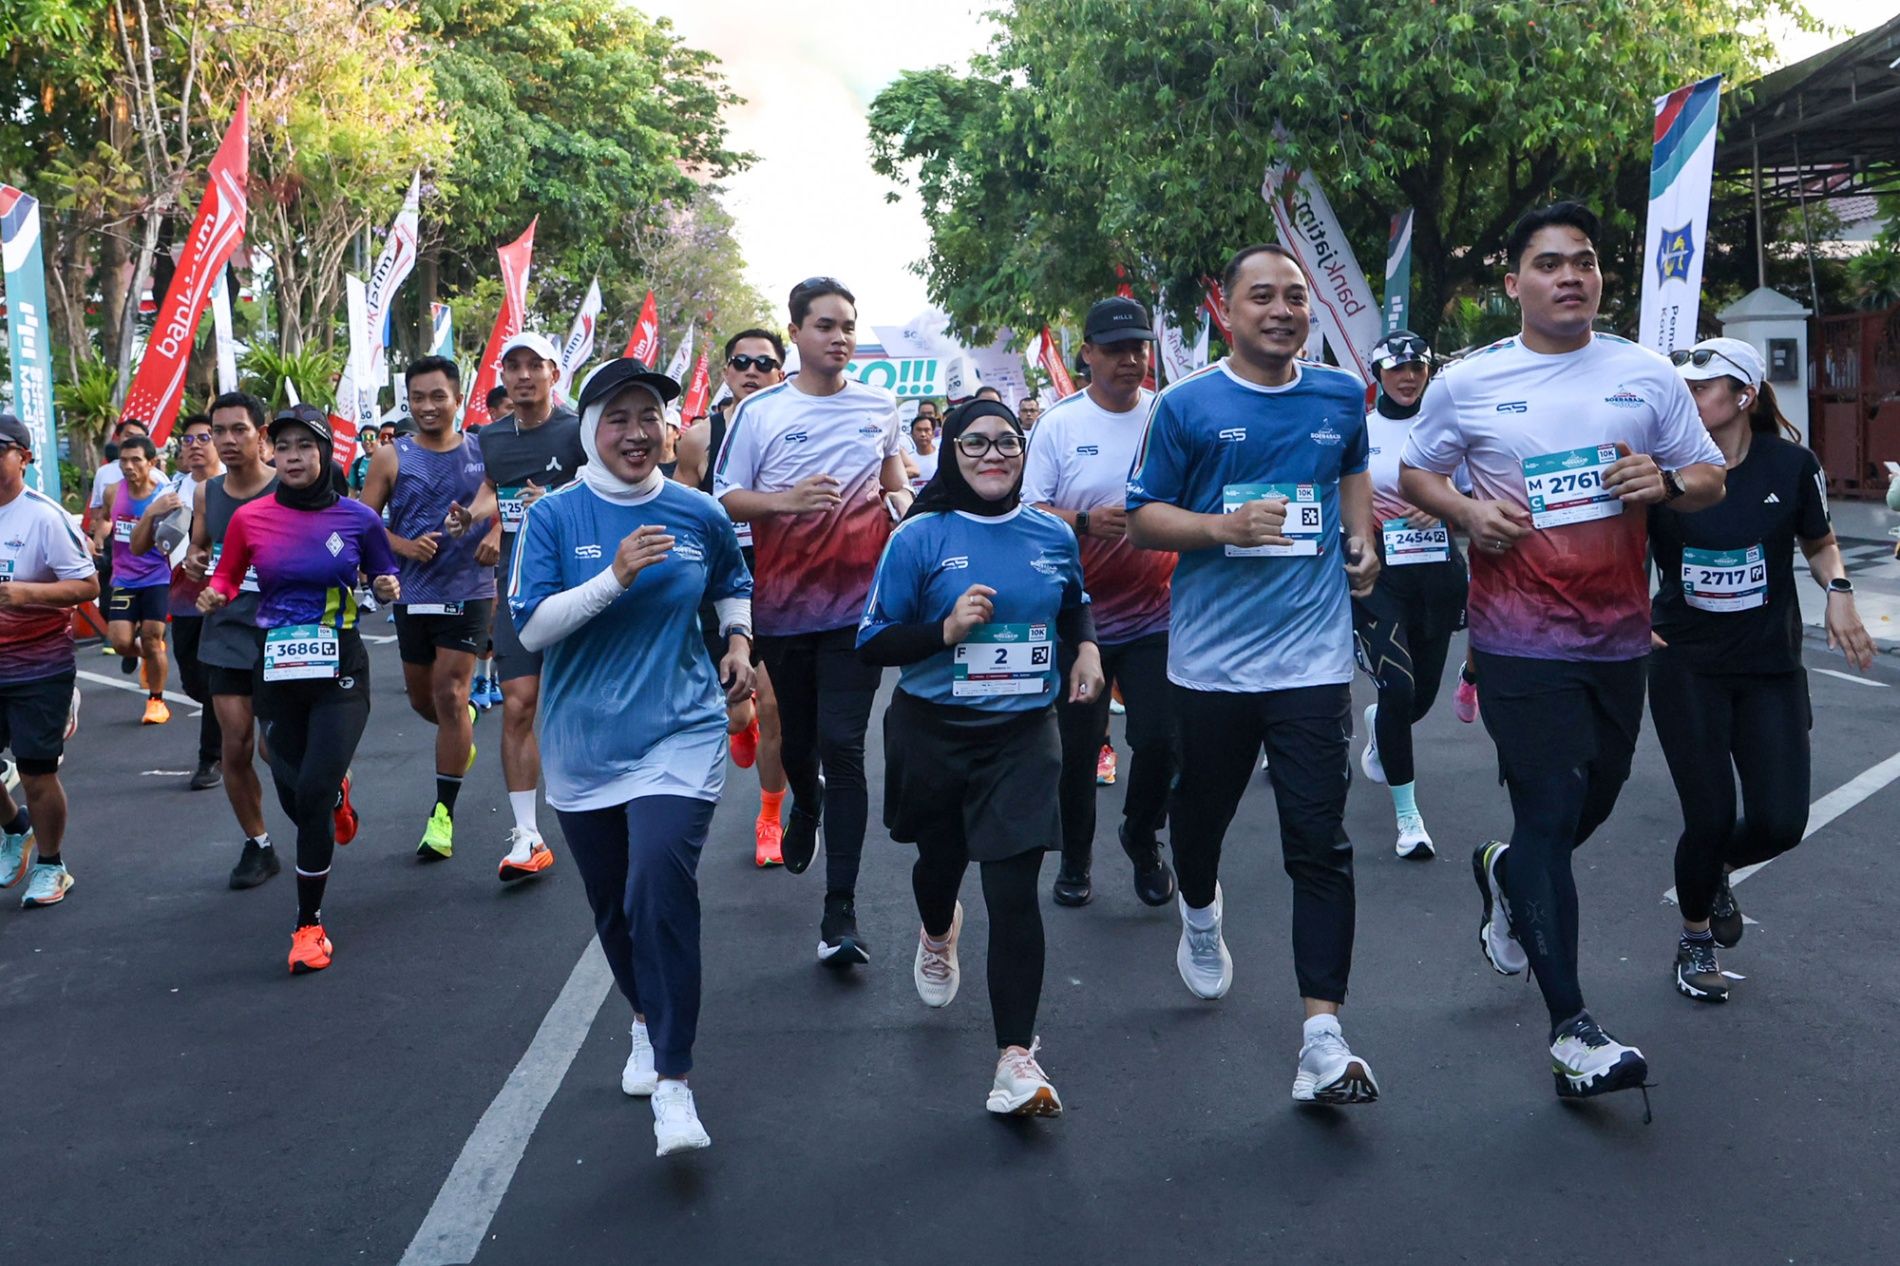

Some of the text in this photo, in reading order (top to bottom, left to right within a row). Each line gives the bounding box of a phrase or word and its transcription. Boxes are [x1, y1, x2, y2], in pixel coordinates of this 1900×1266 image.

[1599, 449, 1615, 458] 10K
[1528, 470, 1601, 495] M 2761
[1298, 489, 1312, 497] 10K
[1531, 497, 1541, 508] C
[1395, 531, 1434, 545] 2454
[1683, 567, 1746, 586] F 2717
[1683, 582, 1692, 591] C
[1030, 628, 1045, 637] 10K
[266, 642, 320, 657] F 3686
[957, 647, 1008, 665] F 2
